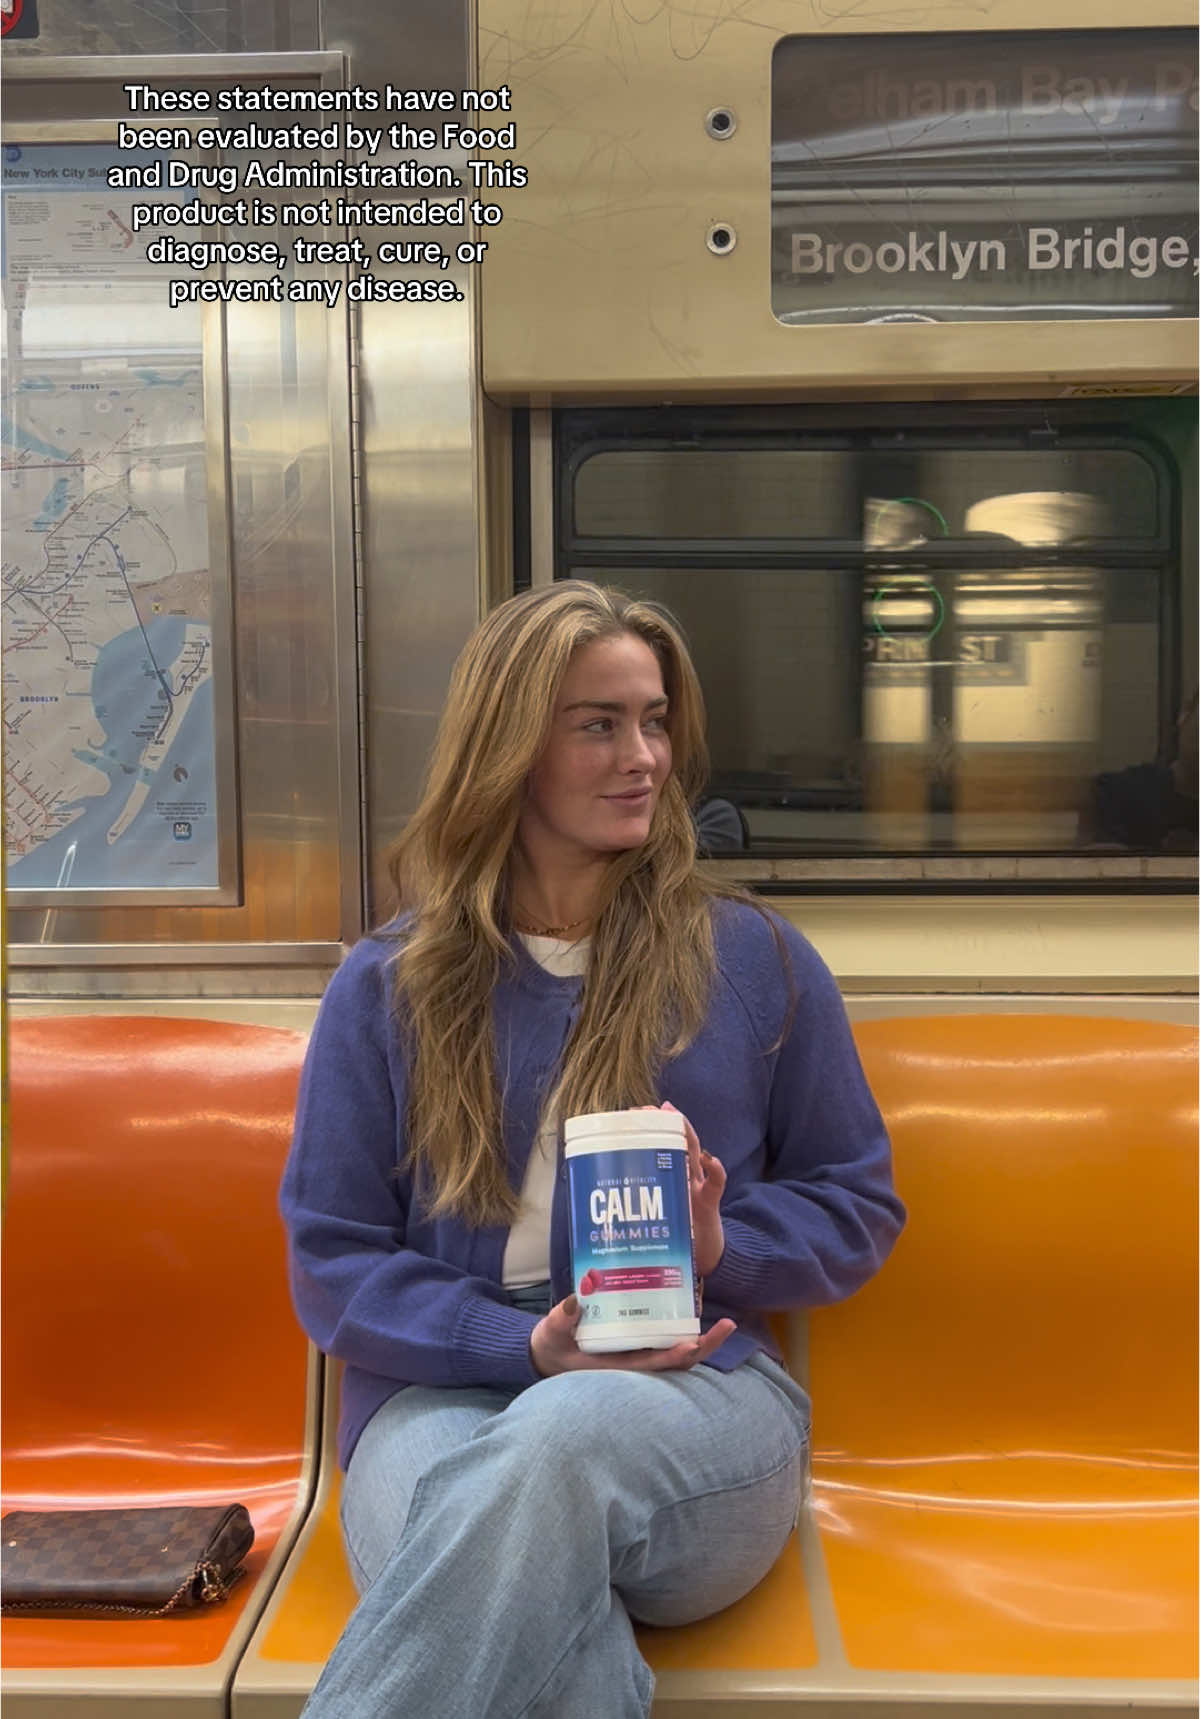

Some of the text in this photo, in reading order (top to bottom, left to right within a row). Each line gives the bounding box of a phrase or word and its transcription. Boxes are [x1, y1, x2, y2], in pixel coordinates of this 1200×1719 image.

[828, 69, 998, 119] elham
[1020, 64, 1128, 124] Bay
[4, 168, 29, 178] New
[33, 168, 58, 178] York
[62, 167, 86, 179] City
[791, 227, 1198, 280] Brooklyn Bridge,
[959, 635, 1002, 662] ST
[590, 1186, 663, 1226] CALM
[590, 1225, 670, 1243] GUMMIES
